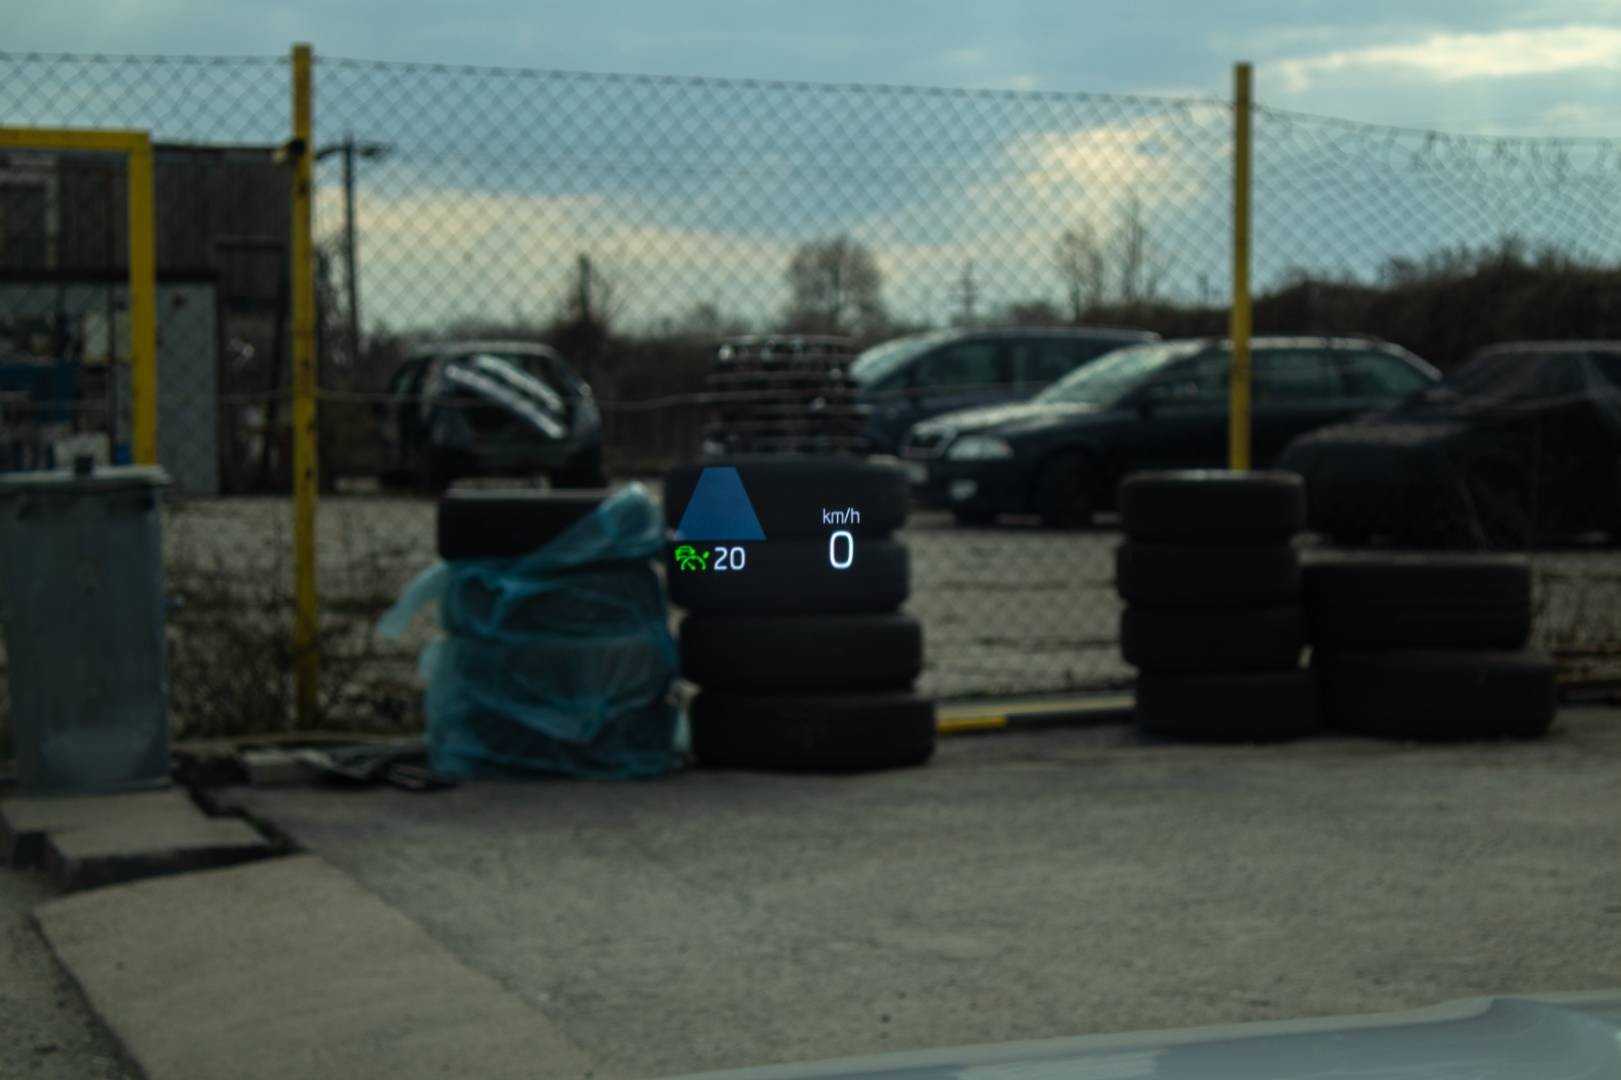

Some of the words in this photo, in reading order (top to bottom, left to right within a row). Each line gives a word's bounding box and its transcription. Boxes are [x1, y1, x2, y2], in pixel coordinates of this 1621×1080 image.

[822, 508, 861, 525] km/h
[713, 546, 746, 571] 20
[829, 530, 854, 570] 0
